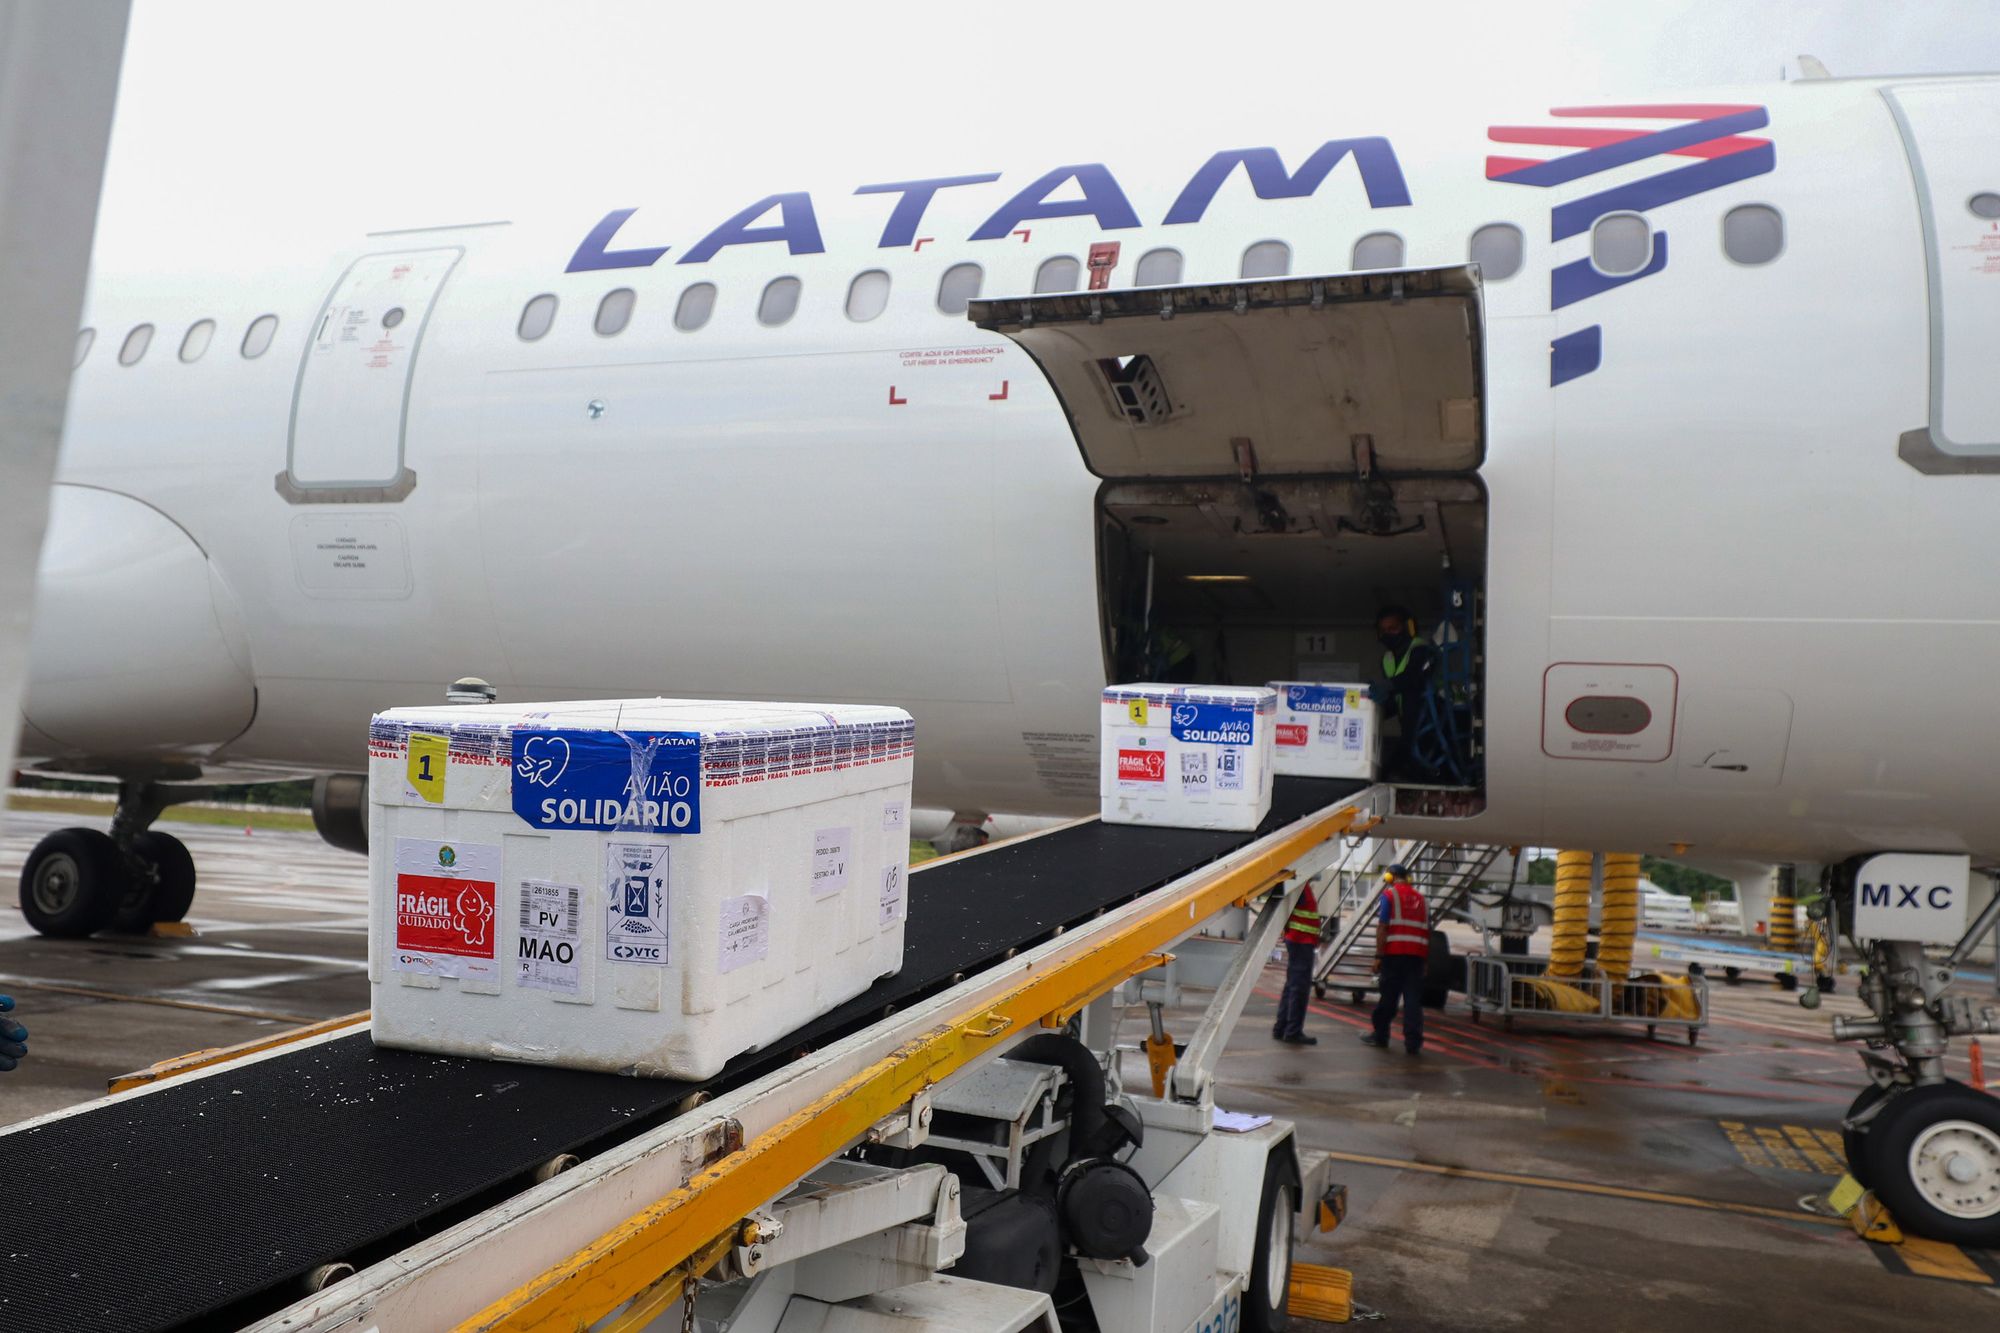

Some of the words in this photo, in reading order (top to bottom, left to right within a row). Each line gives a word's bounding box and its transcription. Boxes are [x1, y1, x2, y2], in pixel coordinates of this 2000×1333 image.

[565, 135, 1413, 273] LATAM
[1306, 636, 1326, 652] 11
[1134, 706, 1142, 718] 1
[1295, 701, 1341, 712] SOLIDÁRIO
[1220, 720, 1250, 731] AVIÃO
[1318, 729, 1337, 737] MAO
[657, 738, 696, 746] LATAM
[1183, 728, 1250, 743] SOLIDÁRIO
[418, 755, 433, 781] 1
[1119, 755, 1145, 767] FRÁGIL
[622, 771, 690, 797] AVIÃO
[1181, 774, 1208, 784] MAO
[398, 891, 452, 917] FRÁGIL
[1861, 883, 1953, 910] MXC
[398, 914, 452, 930] CUIDADO
[539, 911, 559, 927] PV
[518, 936, 574, 965] MAO
[522, 963, 530, 972] R
